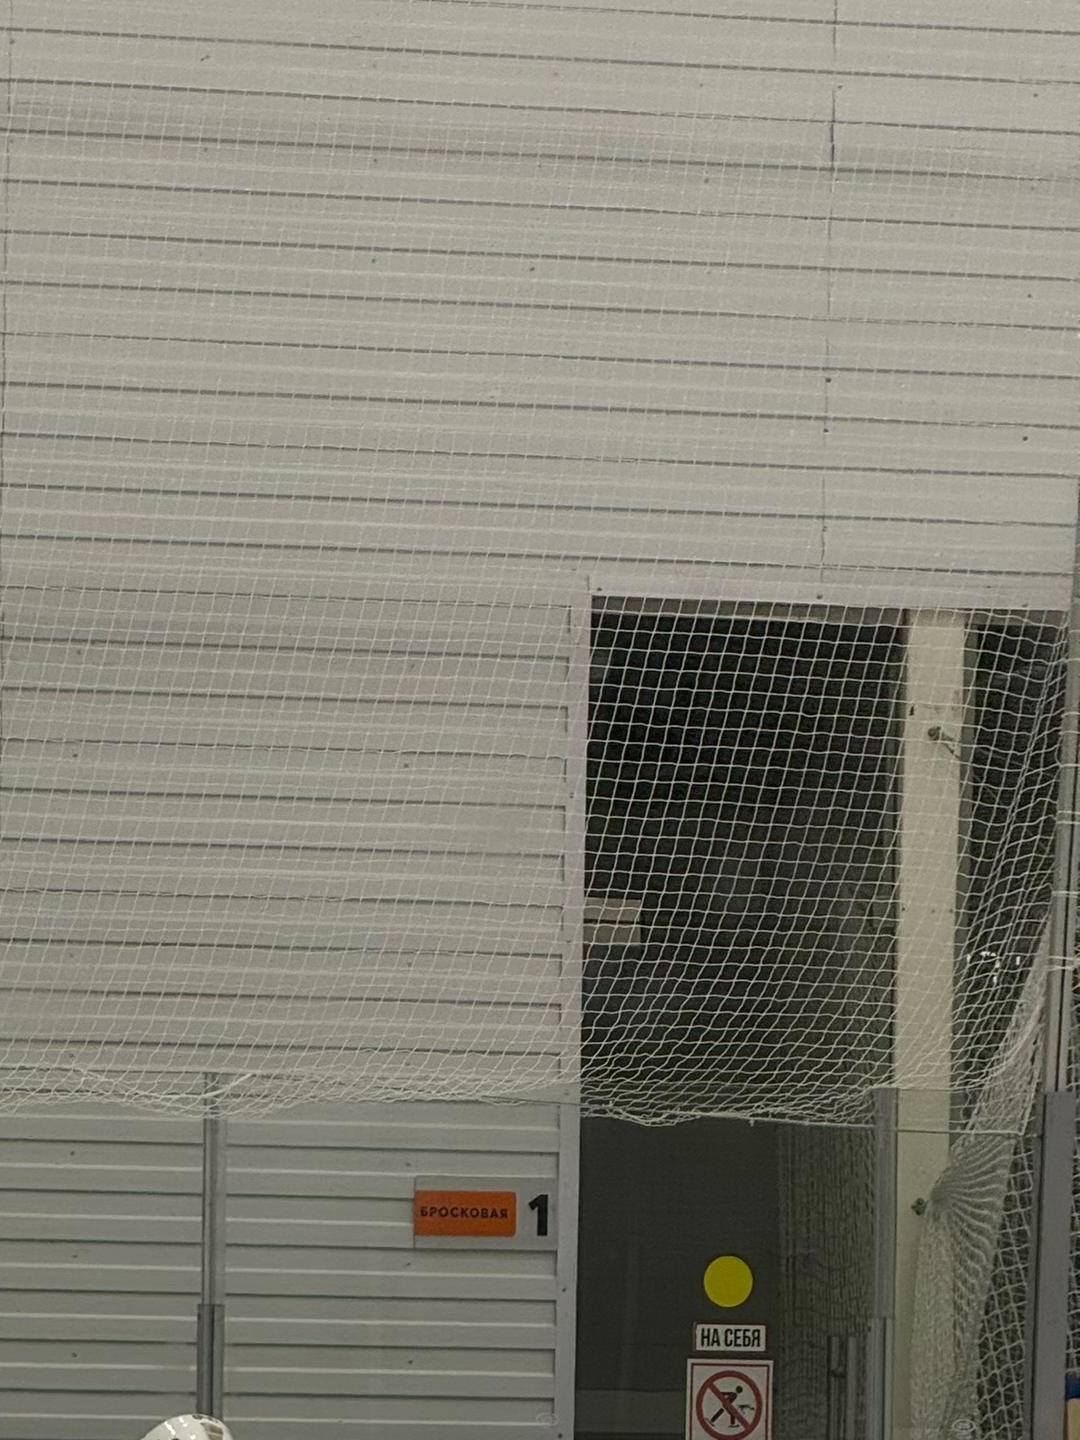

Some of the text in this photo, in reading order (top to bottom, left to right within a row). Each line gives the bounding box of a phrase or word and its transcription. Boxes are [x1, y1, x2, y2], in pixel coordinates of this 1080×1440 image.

[420, 1194, 549, 1236] БРОСКОВАЯ 1
[700, 1327, 761, 1348] НА СЕБЯ
